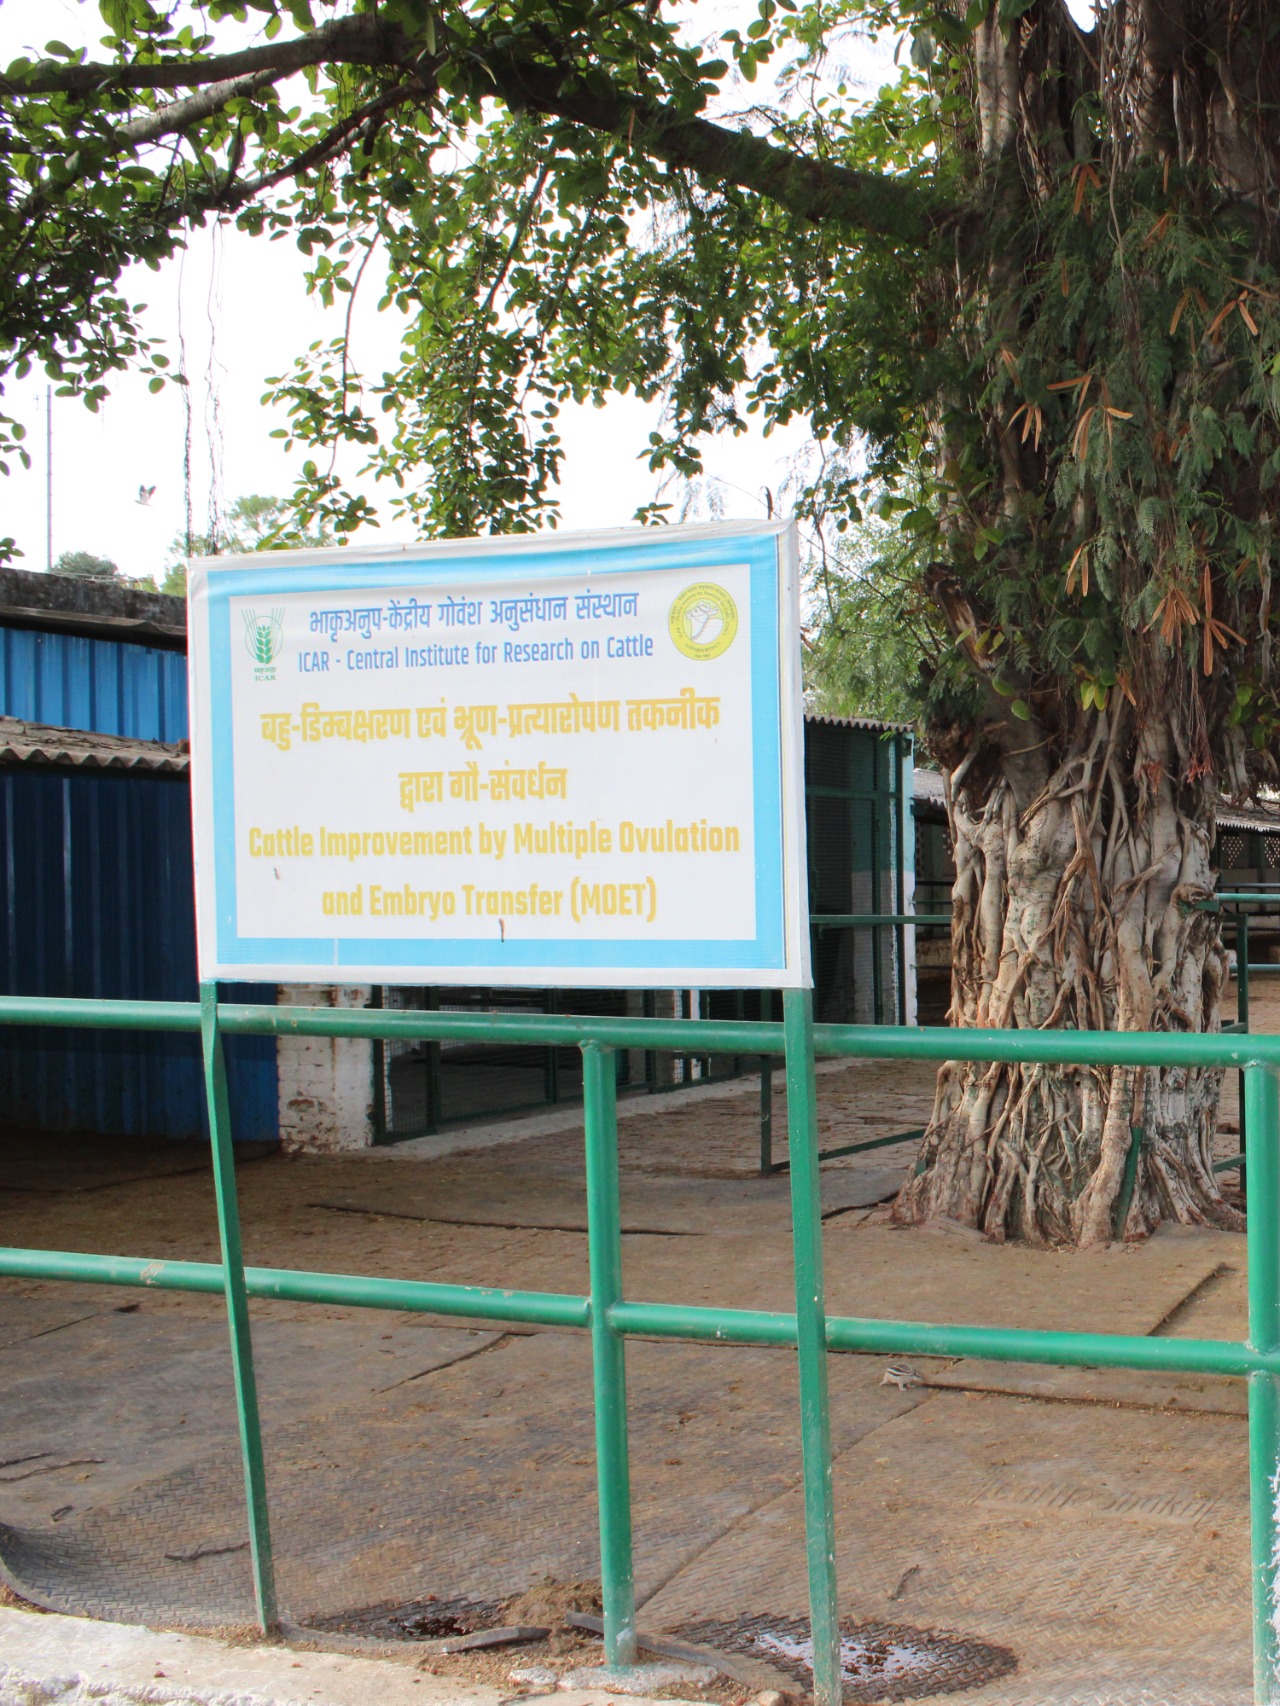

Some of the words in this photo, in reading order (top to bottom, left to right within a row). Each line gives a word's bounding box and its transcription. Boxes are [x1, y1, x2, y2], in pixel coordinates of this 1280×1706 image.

[309, 598, 431, 642] भाकृअनुप-केंद्रीय
[437, 594, 482, 627] गोवंश
[489, 592, 568, 632] अनुसंधान
[574, 588, 640, 620] संस्थान
[298, 651, 330, 673] ICAR
[347, 646, 398, 671] Central
[405, 643, 469, 668] Institute
[475, 640, 498, 665] for
[504, 637, 573, 663] Research
[580, 639, 600, 661] on
[606, 633, 654, 659] Cattle
[260, 702, 411, 751] बहु-डिम्बक्षरण
[415, 696, 448, 738] एवं
[454, 692, 621, 750] भ्रूण-प्रत्यारोपण
[625, 687, 721, 732] तकनीक
[398, 771, 445, 813] द्वारा
[448, 759, 568, 802] गौ-संवर्धन
[249, 826, 314, 858] Cattle
[320, 825, 473, 863] Improvement
[479, 822, 507, 861] by
[513, 821, 612, 861] Multiple
[619, 818, 740, 854] Ovulation
[322, 884, 363, 916] and
[370, 884, 456, 922] Embryo
[462, 882, 564, 917] Transfer
[570, 876, 657, 924] (MOET)
